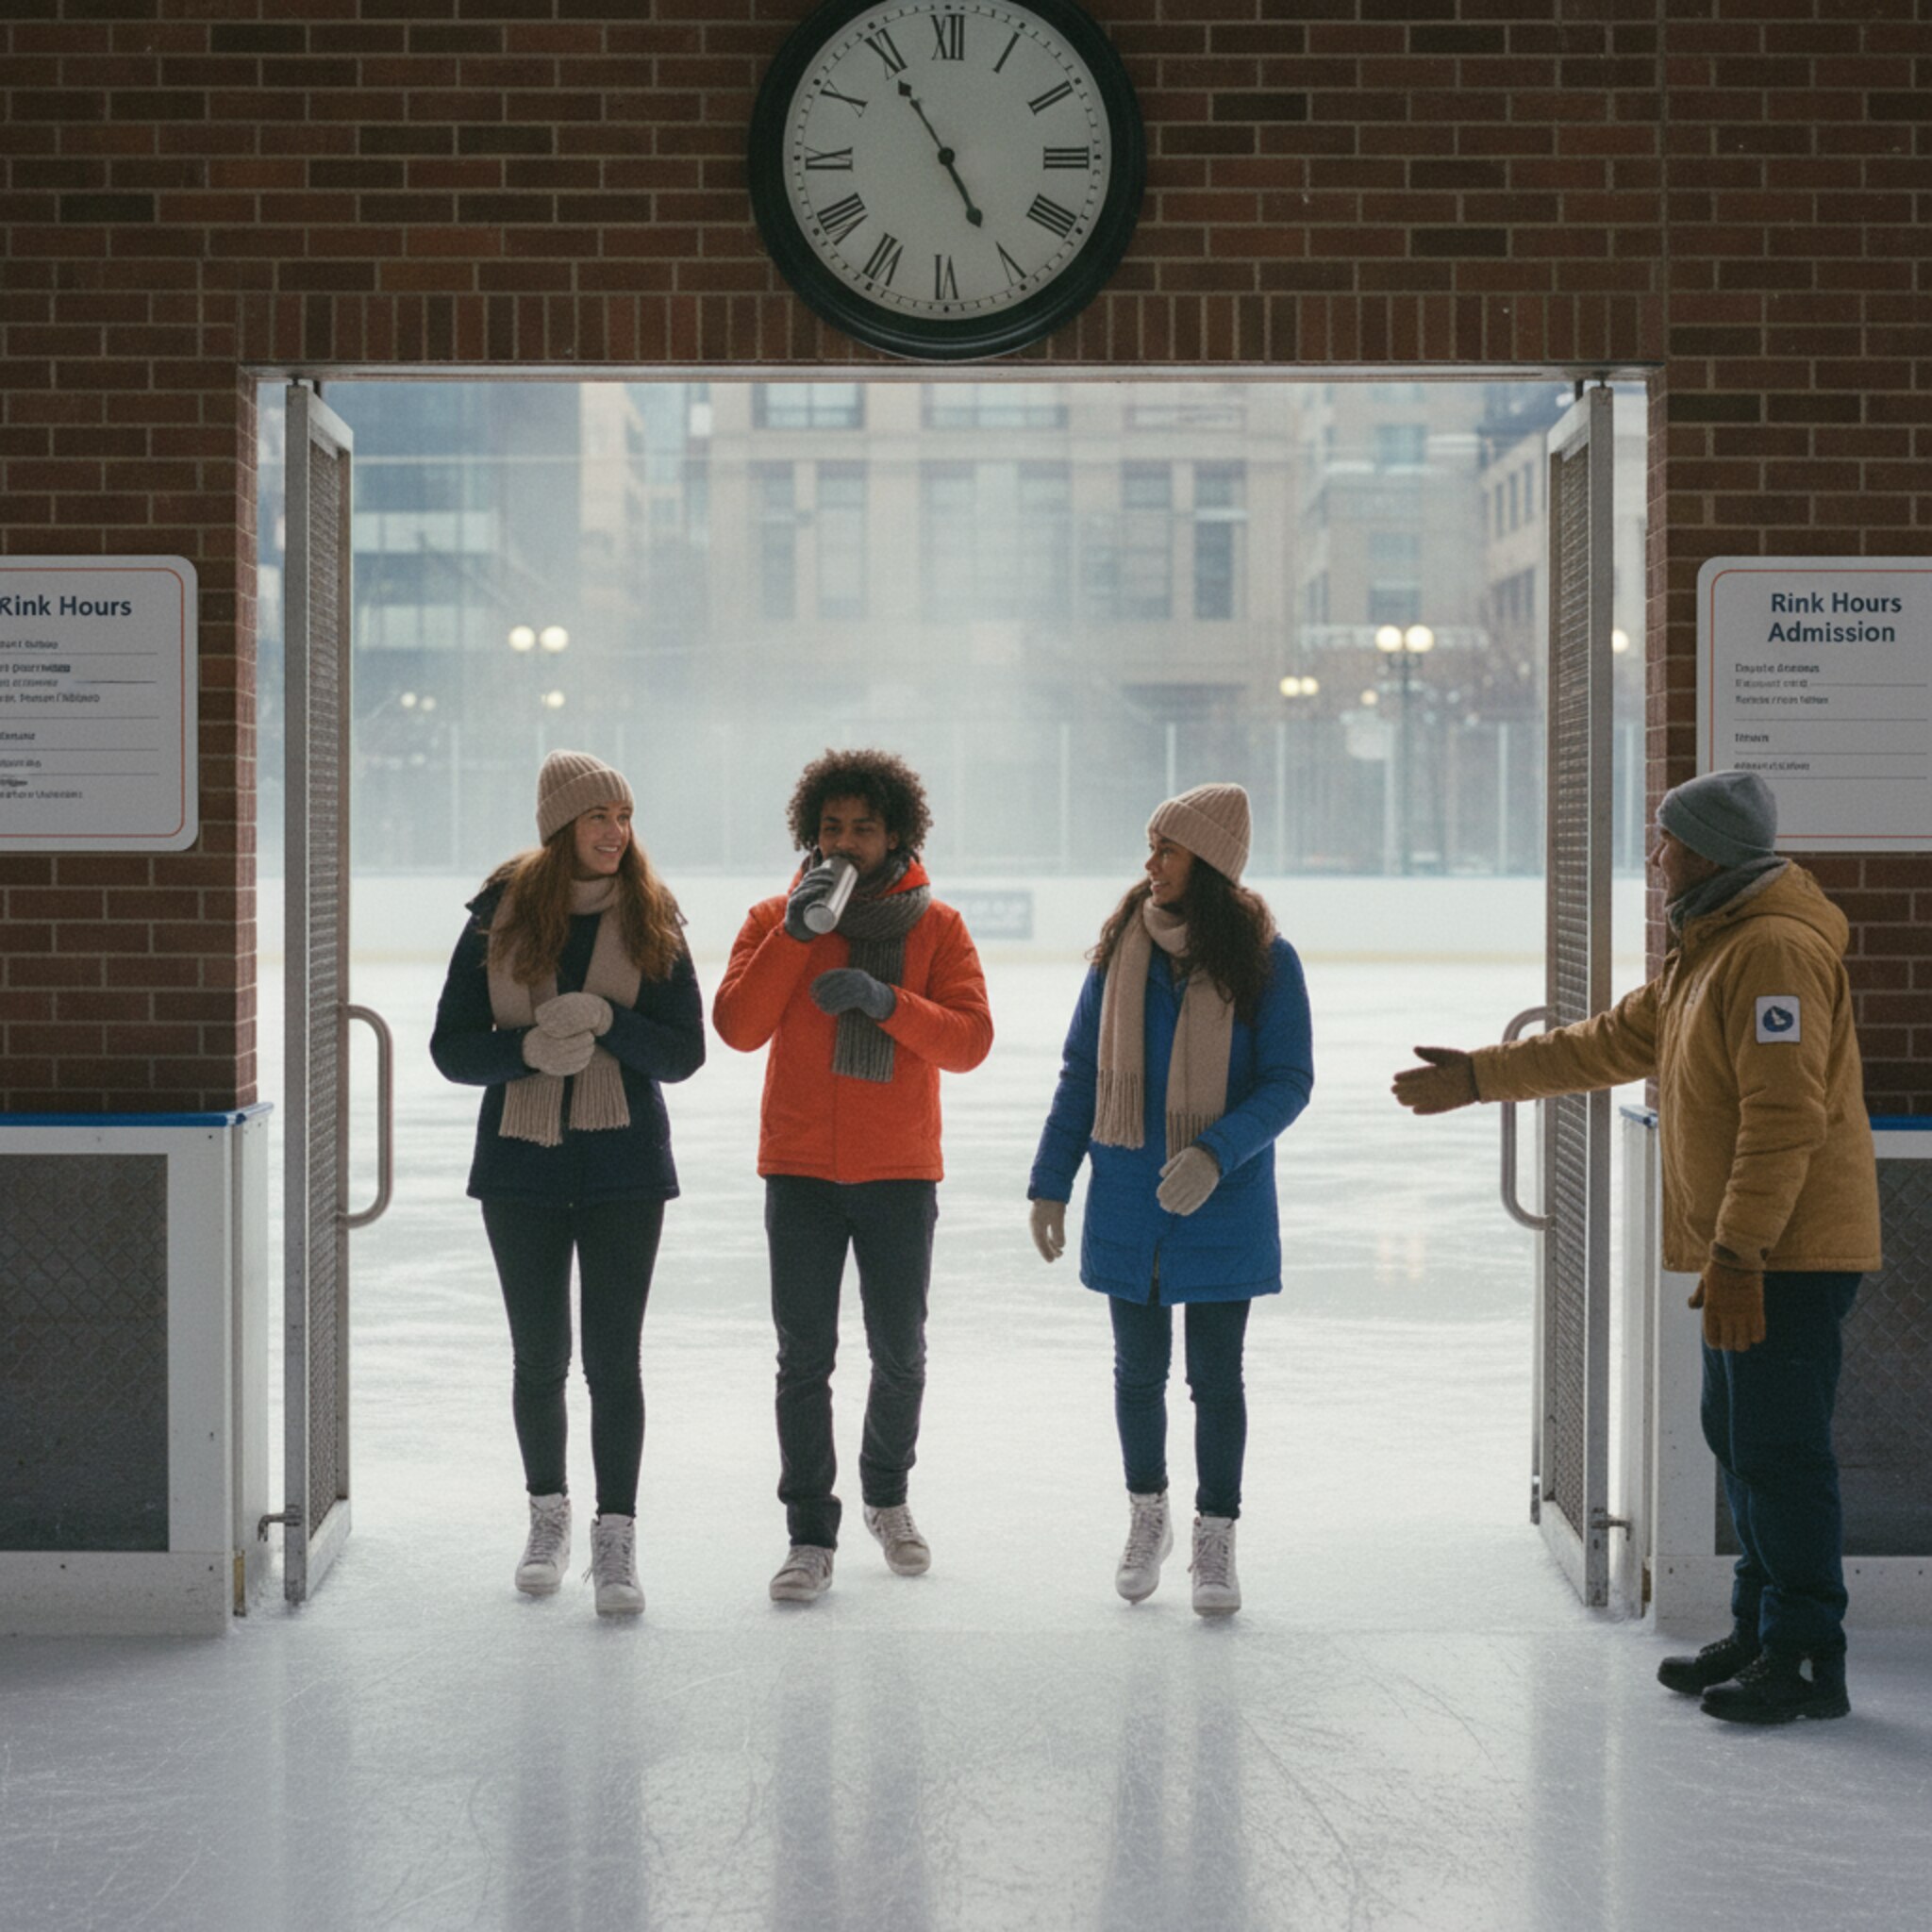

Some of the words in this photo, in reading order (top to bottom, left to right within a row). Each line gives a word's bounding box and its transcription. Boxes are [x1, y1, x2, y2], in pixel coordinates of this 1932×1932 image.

[930, 14, 965, 60] XII
[993, 32, 1021, 73] I
[820, 79, 868, 118] X
[1027, 80, 1074, 115] II
[1042, 146, 1090, 170] III
[995, 241, 1027, 286] V
[0, 594, 51, 616] Rink
[59, 596, 131, 616] Hours
[1771, 592, 1824, 613] Rink
[1832, 592, 1903, 613] Hours
[1768, 621, 1895, 642] Admission
